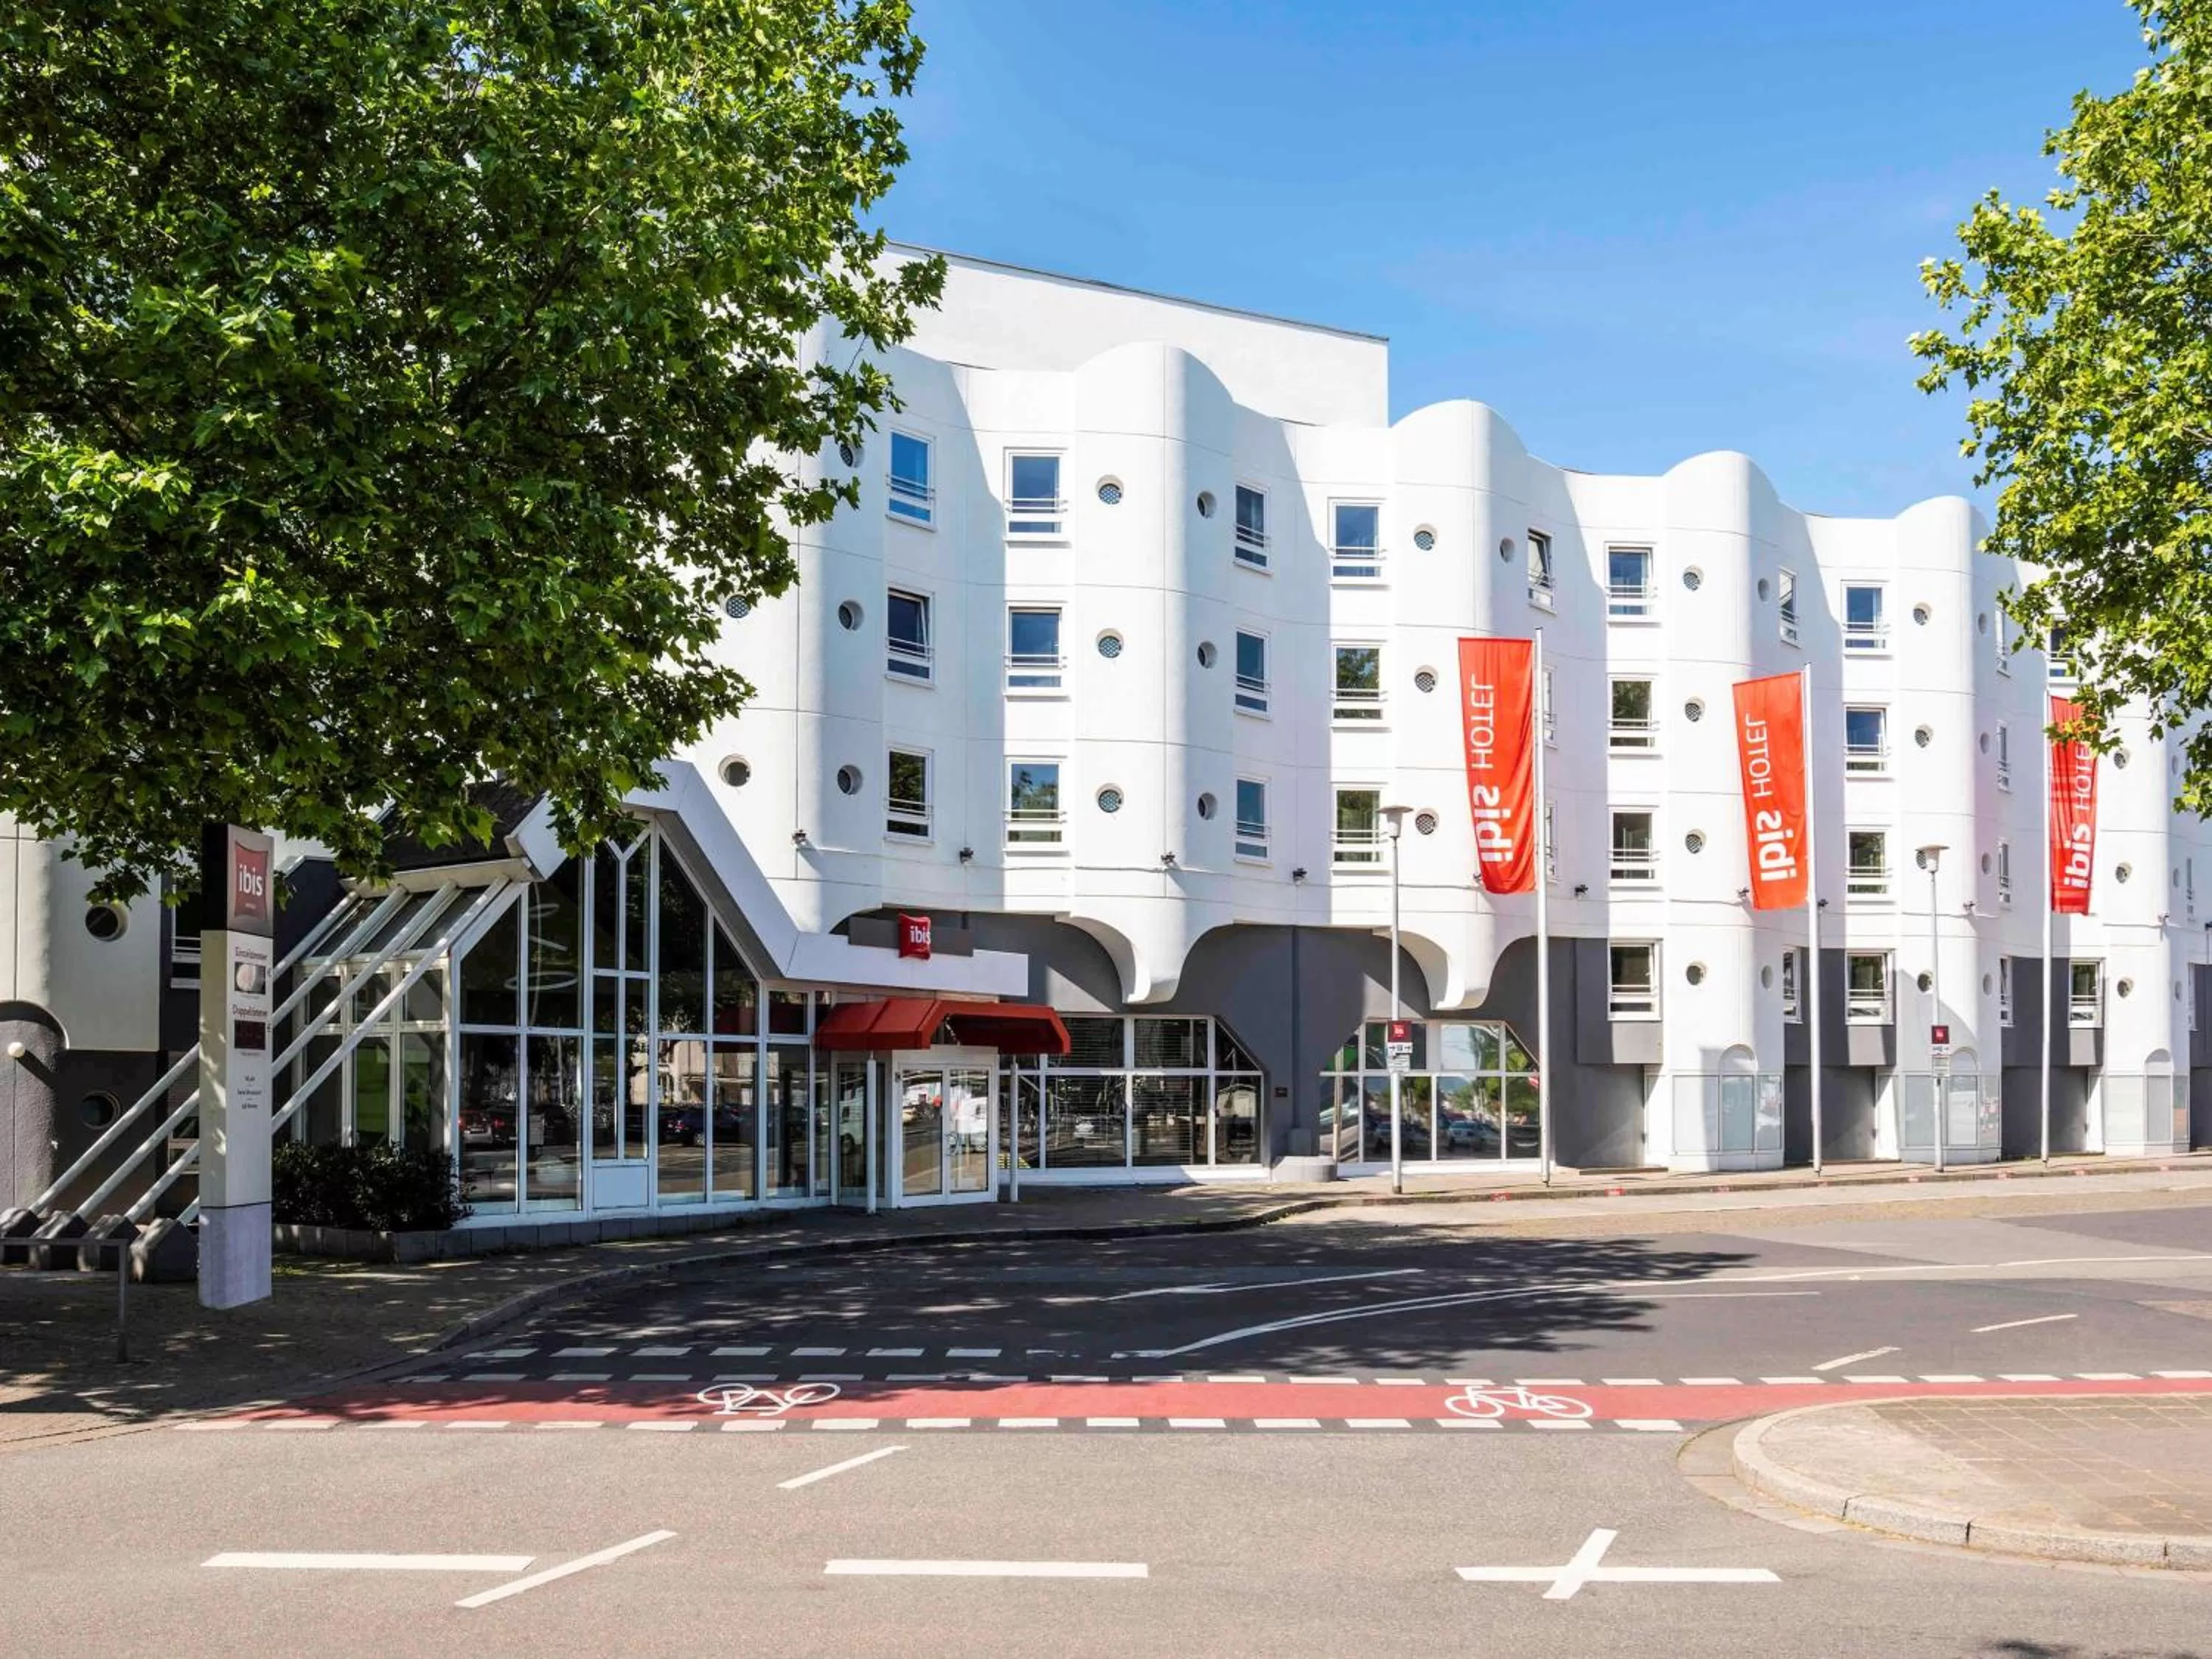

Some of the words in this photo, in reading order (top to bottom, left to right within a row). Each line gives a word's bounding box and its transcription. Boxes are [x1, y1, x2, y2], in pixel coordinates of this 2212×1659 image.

[2064, 822, 2091, 888] ibis
[239, 863, 263, 897] ibis
[909, 925, 931, 945] ibis
